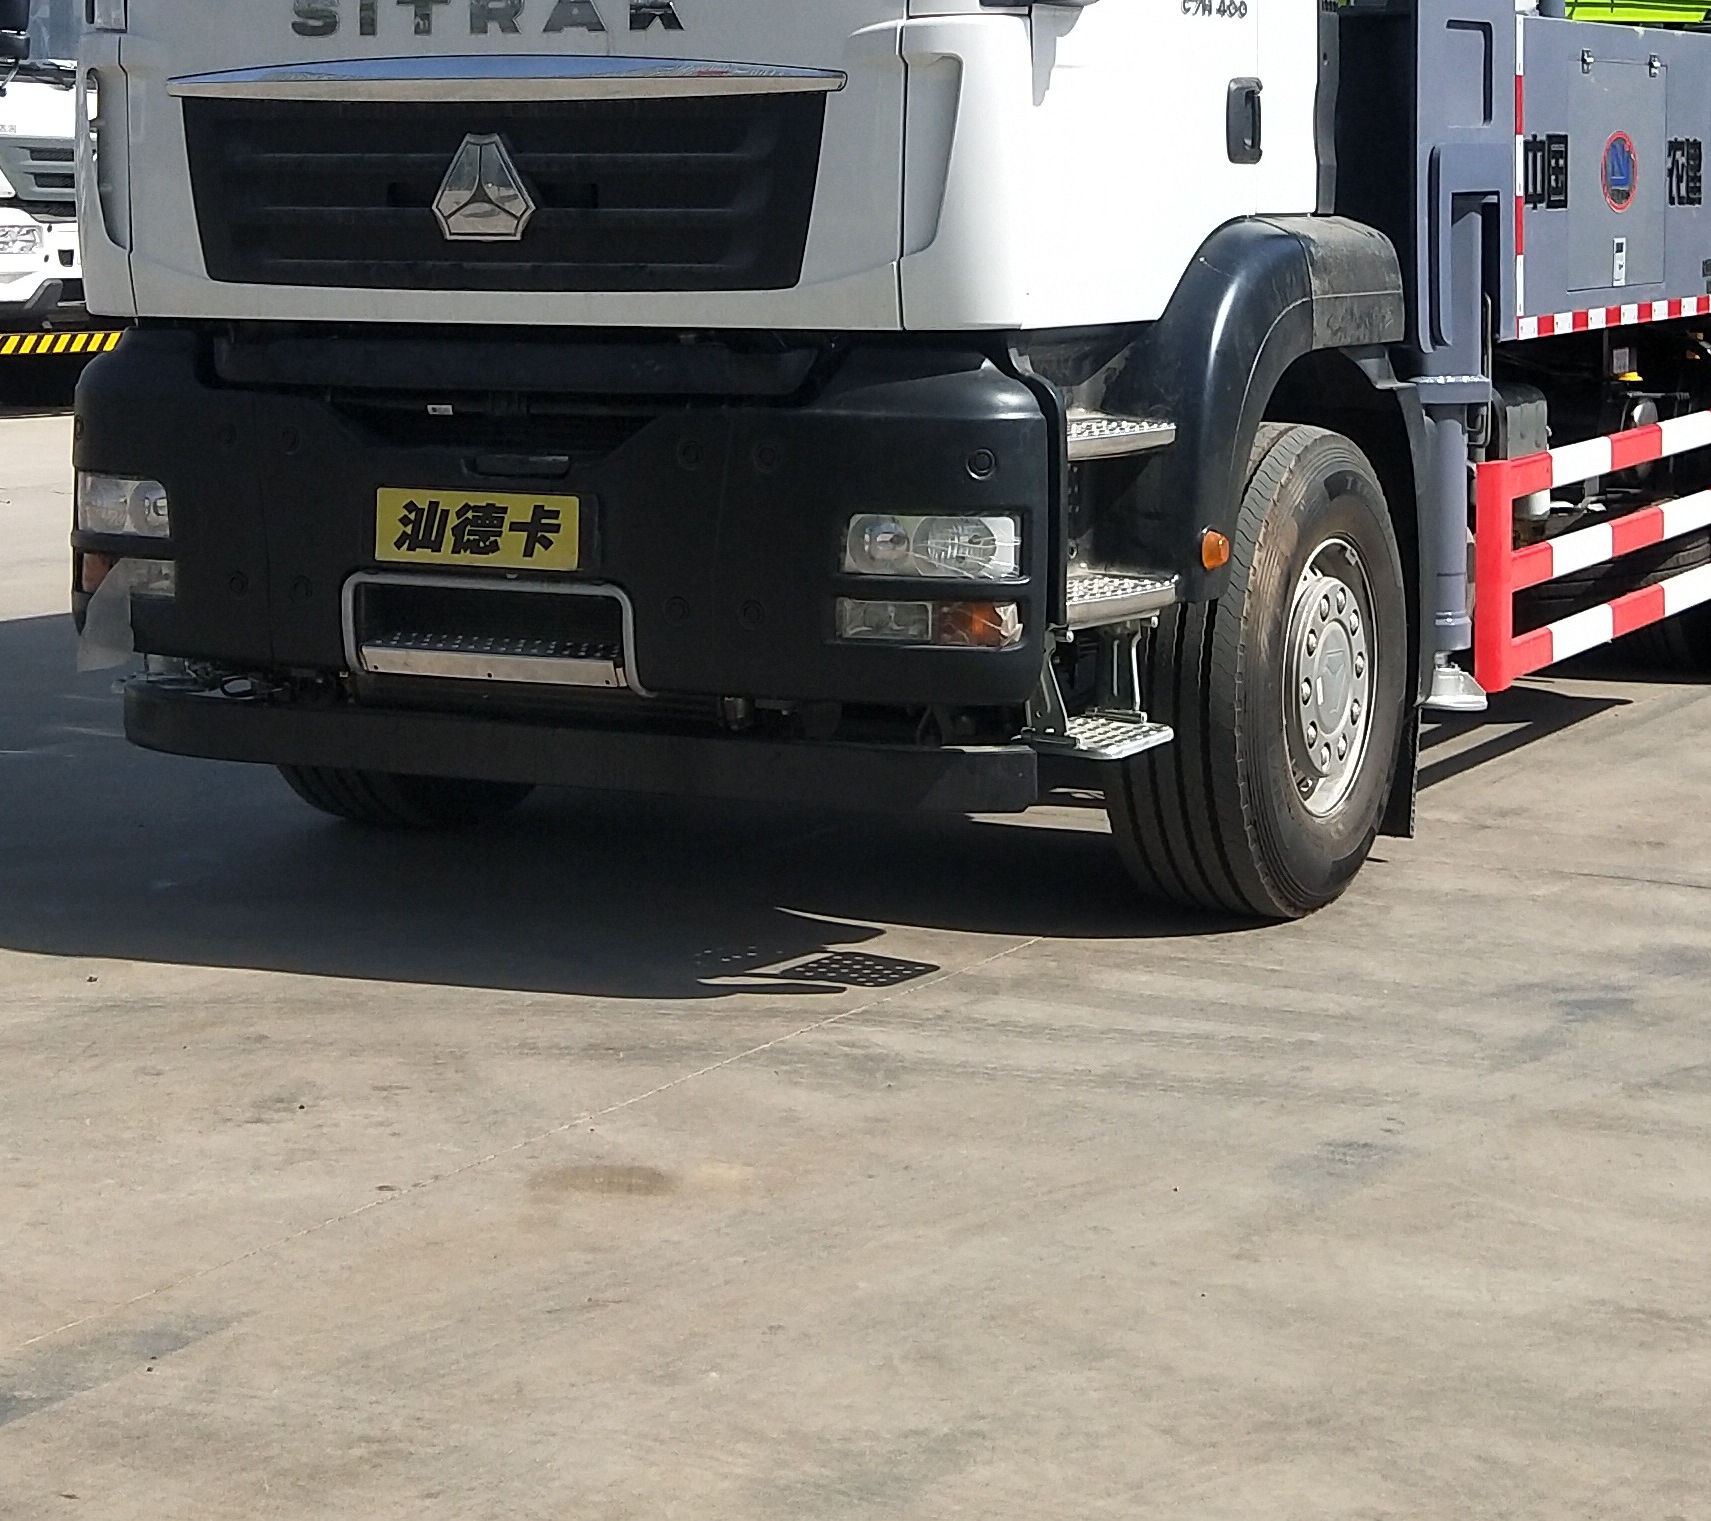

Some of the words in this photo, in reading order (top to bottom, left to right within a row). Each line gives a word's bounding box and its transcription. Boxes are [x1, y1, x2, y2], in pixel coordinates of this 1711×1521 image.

[1216, 0, 1247, 19] 400
[1523, 133, 1568, 210] 中国
[393, 499, 562, 558] 汕德卡
